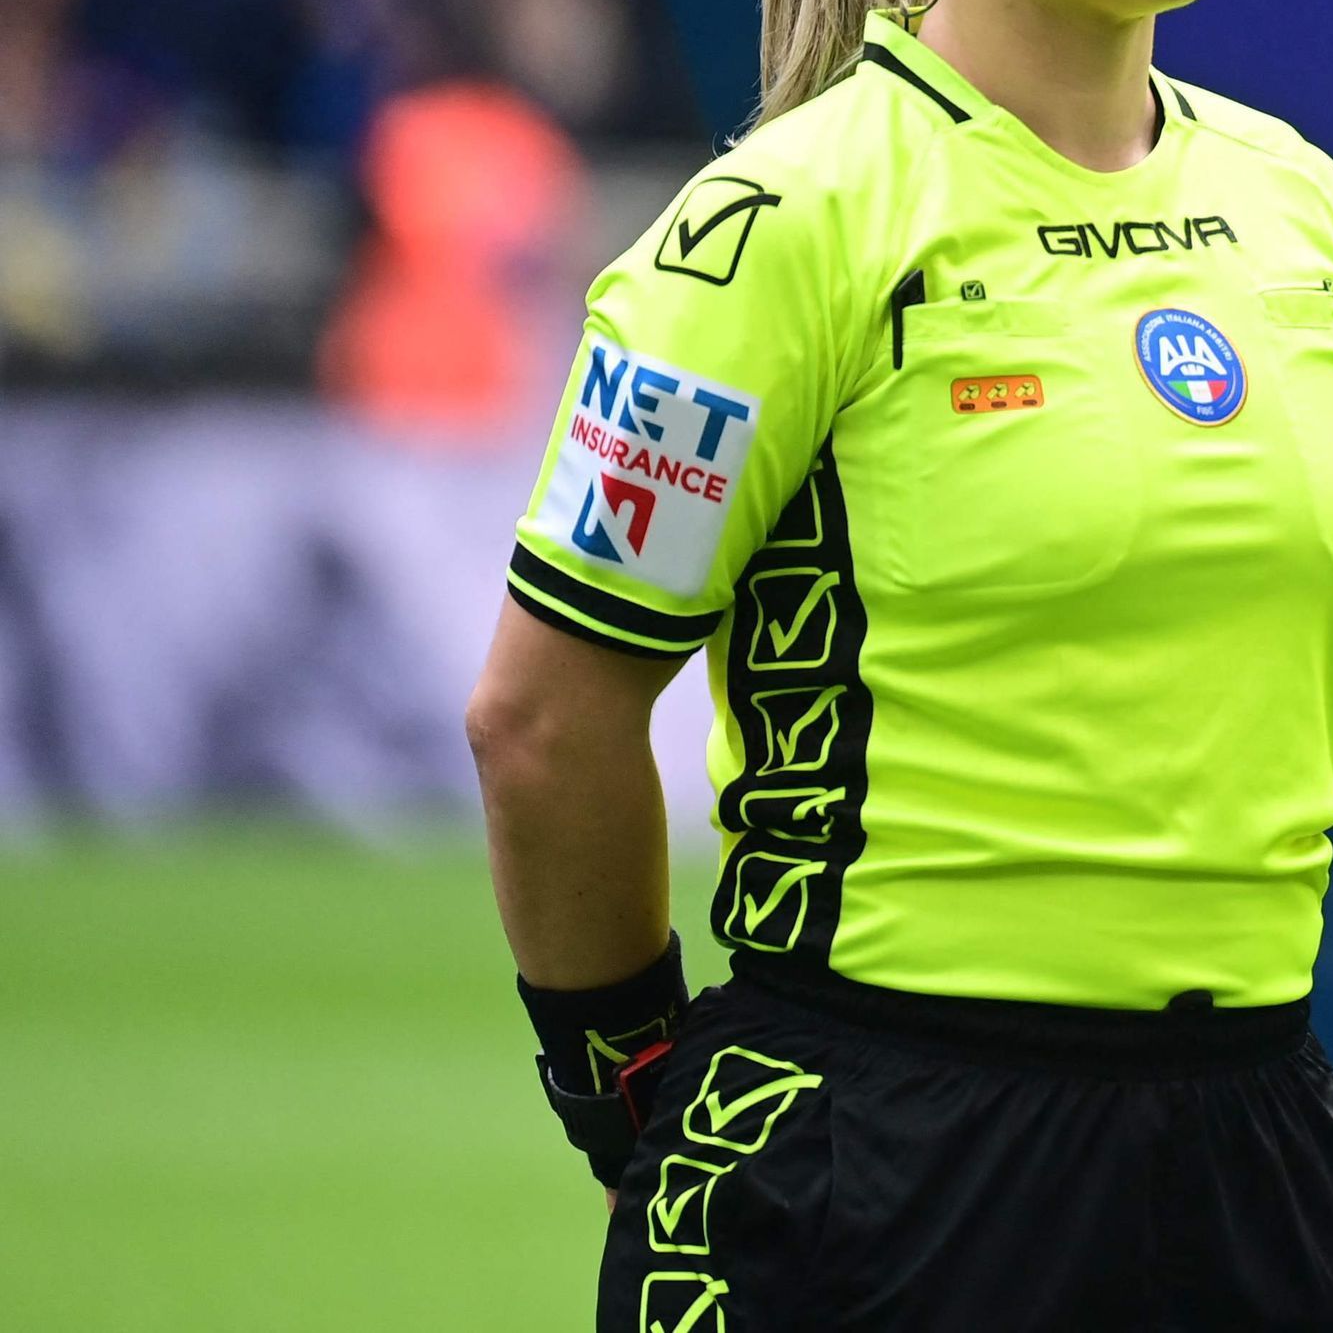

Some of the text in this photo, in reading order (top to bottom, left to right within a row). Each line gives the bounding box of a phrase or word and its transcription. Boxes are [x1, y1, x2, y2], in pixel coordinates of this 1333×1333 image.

[1037, 216, 1238, 259] GIVOVA
[581, 345, 750, 462] NET
[571, 414, 728, 504] INSURANCE
